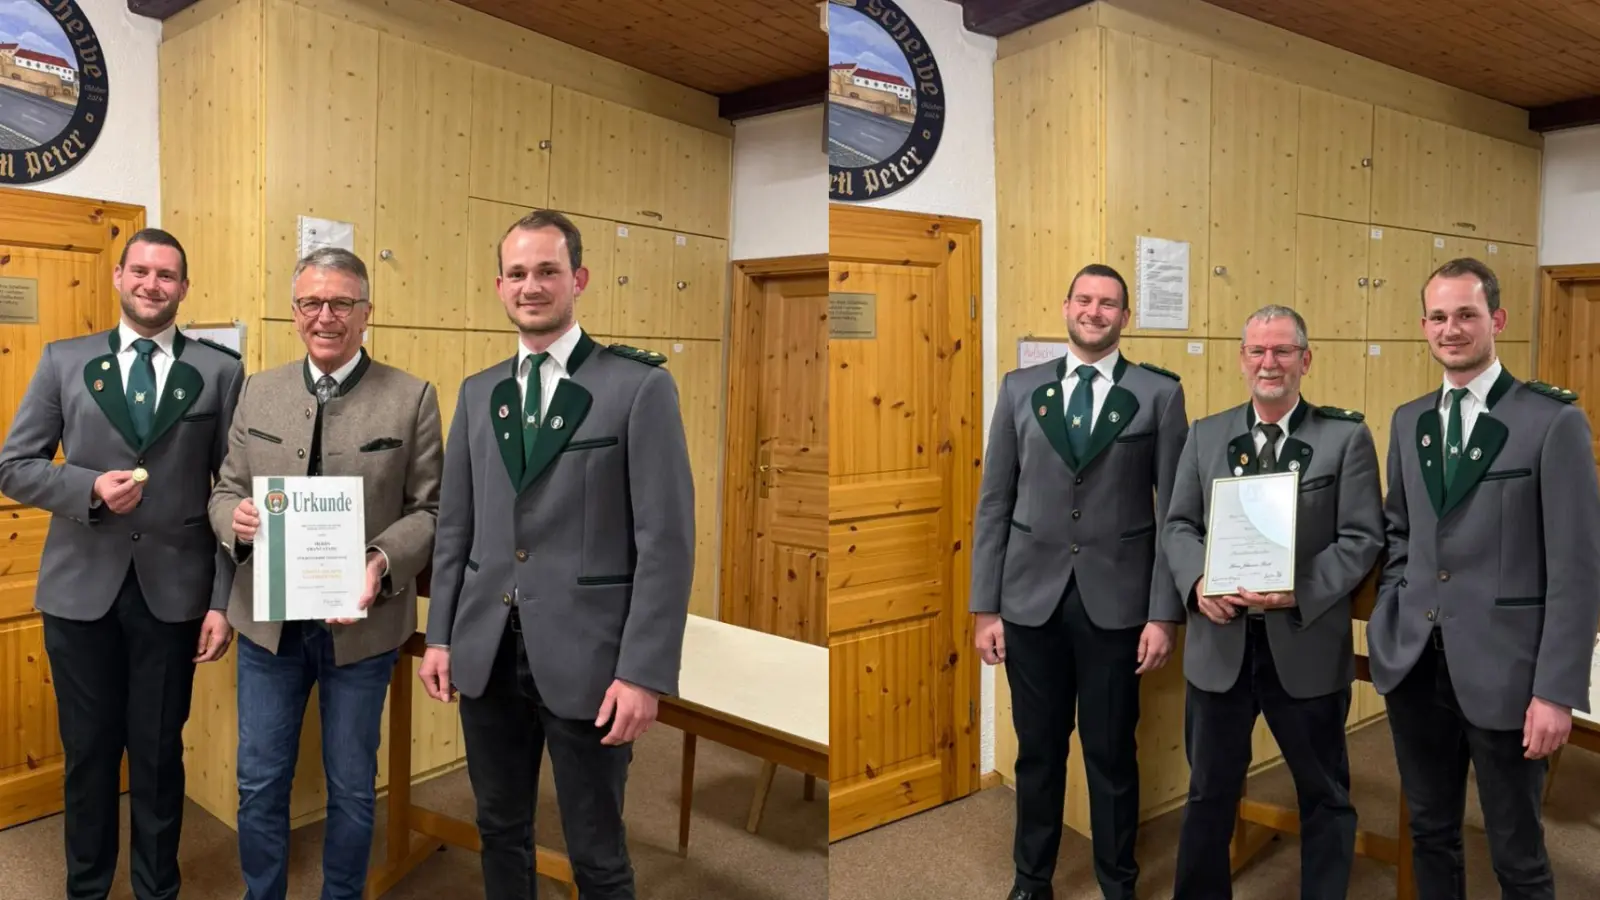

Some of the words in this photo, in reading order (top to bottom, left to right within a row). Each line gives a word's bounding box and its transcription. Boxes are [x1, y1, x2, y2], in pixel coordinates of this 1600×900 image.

[25, 129, 86, 179] Peter
[864, 146, 923, 196] Peter
[292, 491, 352, 513] Urkunde
